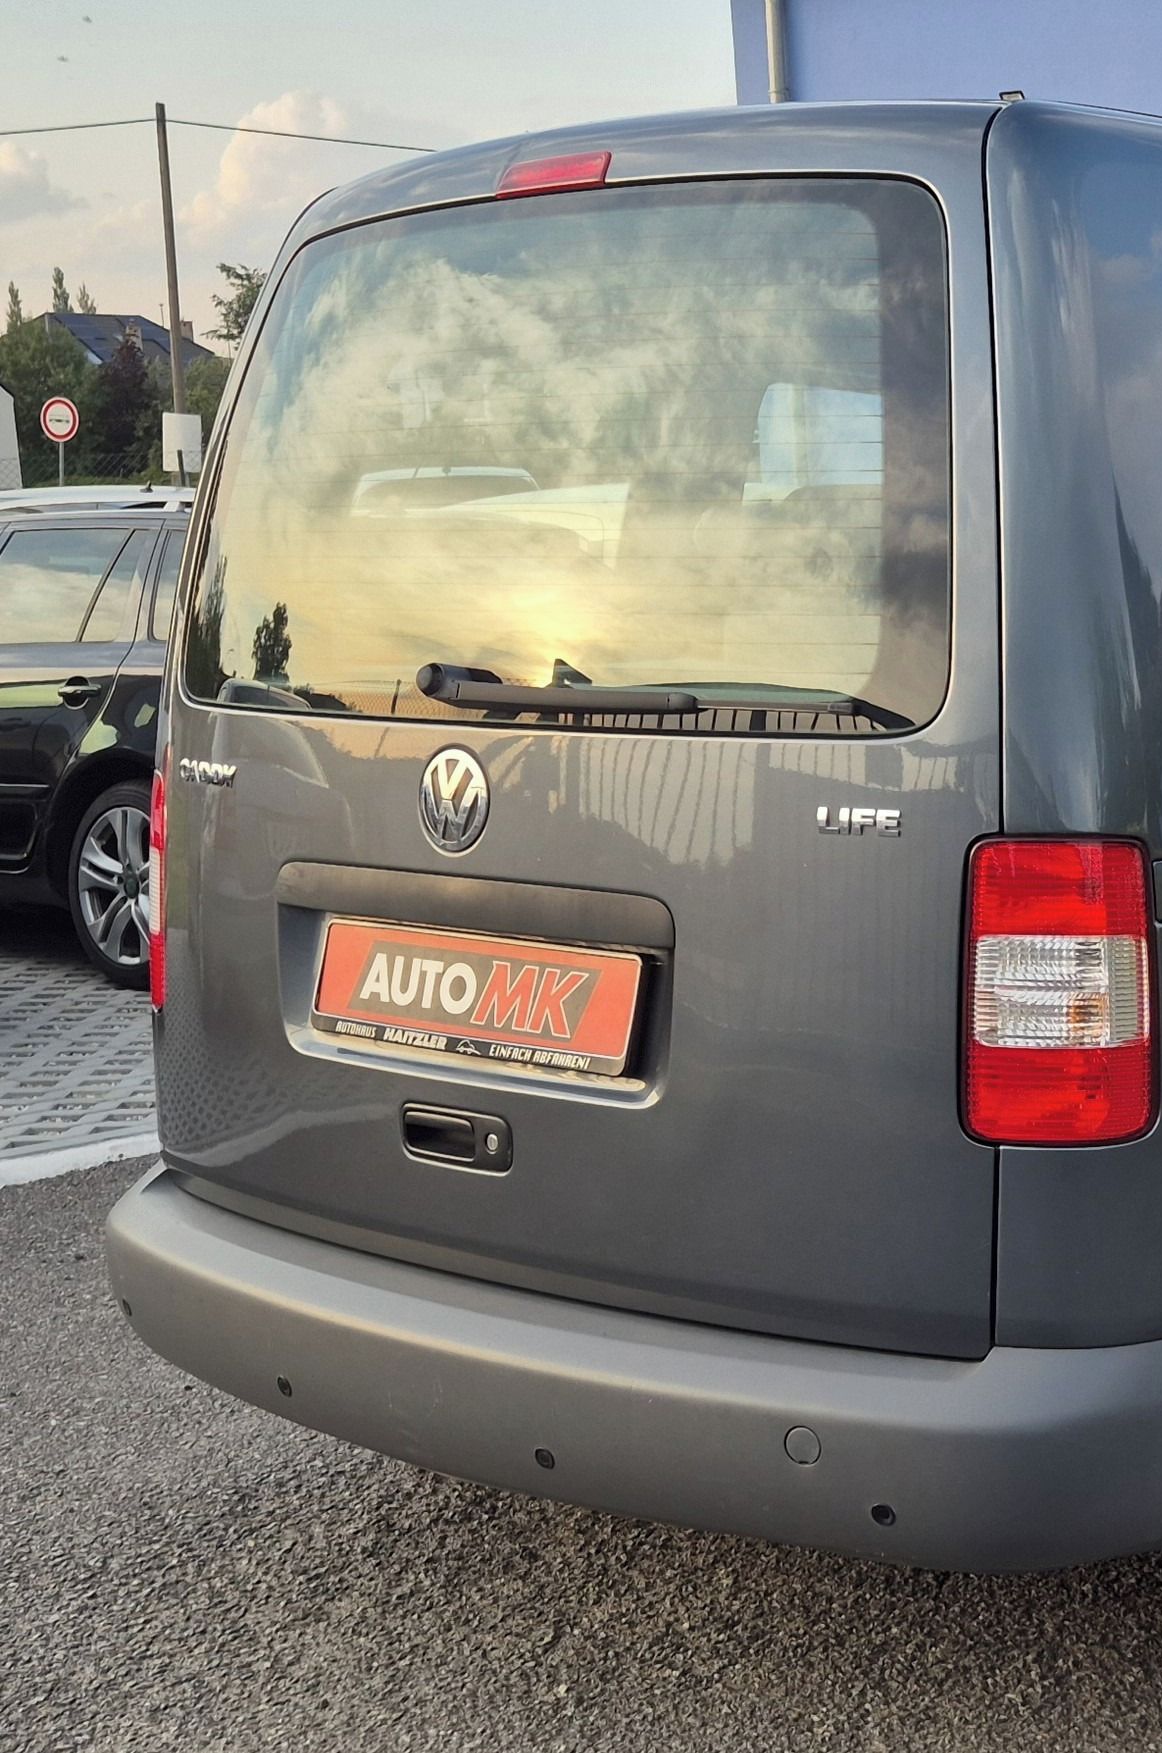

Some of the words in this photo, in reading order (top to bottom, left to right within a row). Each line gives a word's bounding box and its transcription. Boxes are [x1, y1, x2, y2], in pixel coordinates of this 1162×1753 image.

[816, 806, 901, 837] LIFE
[335, 1020, 377, 1038] AUTOHAUS
[488, 1044, 533, 1062] EINFACH
